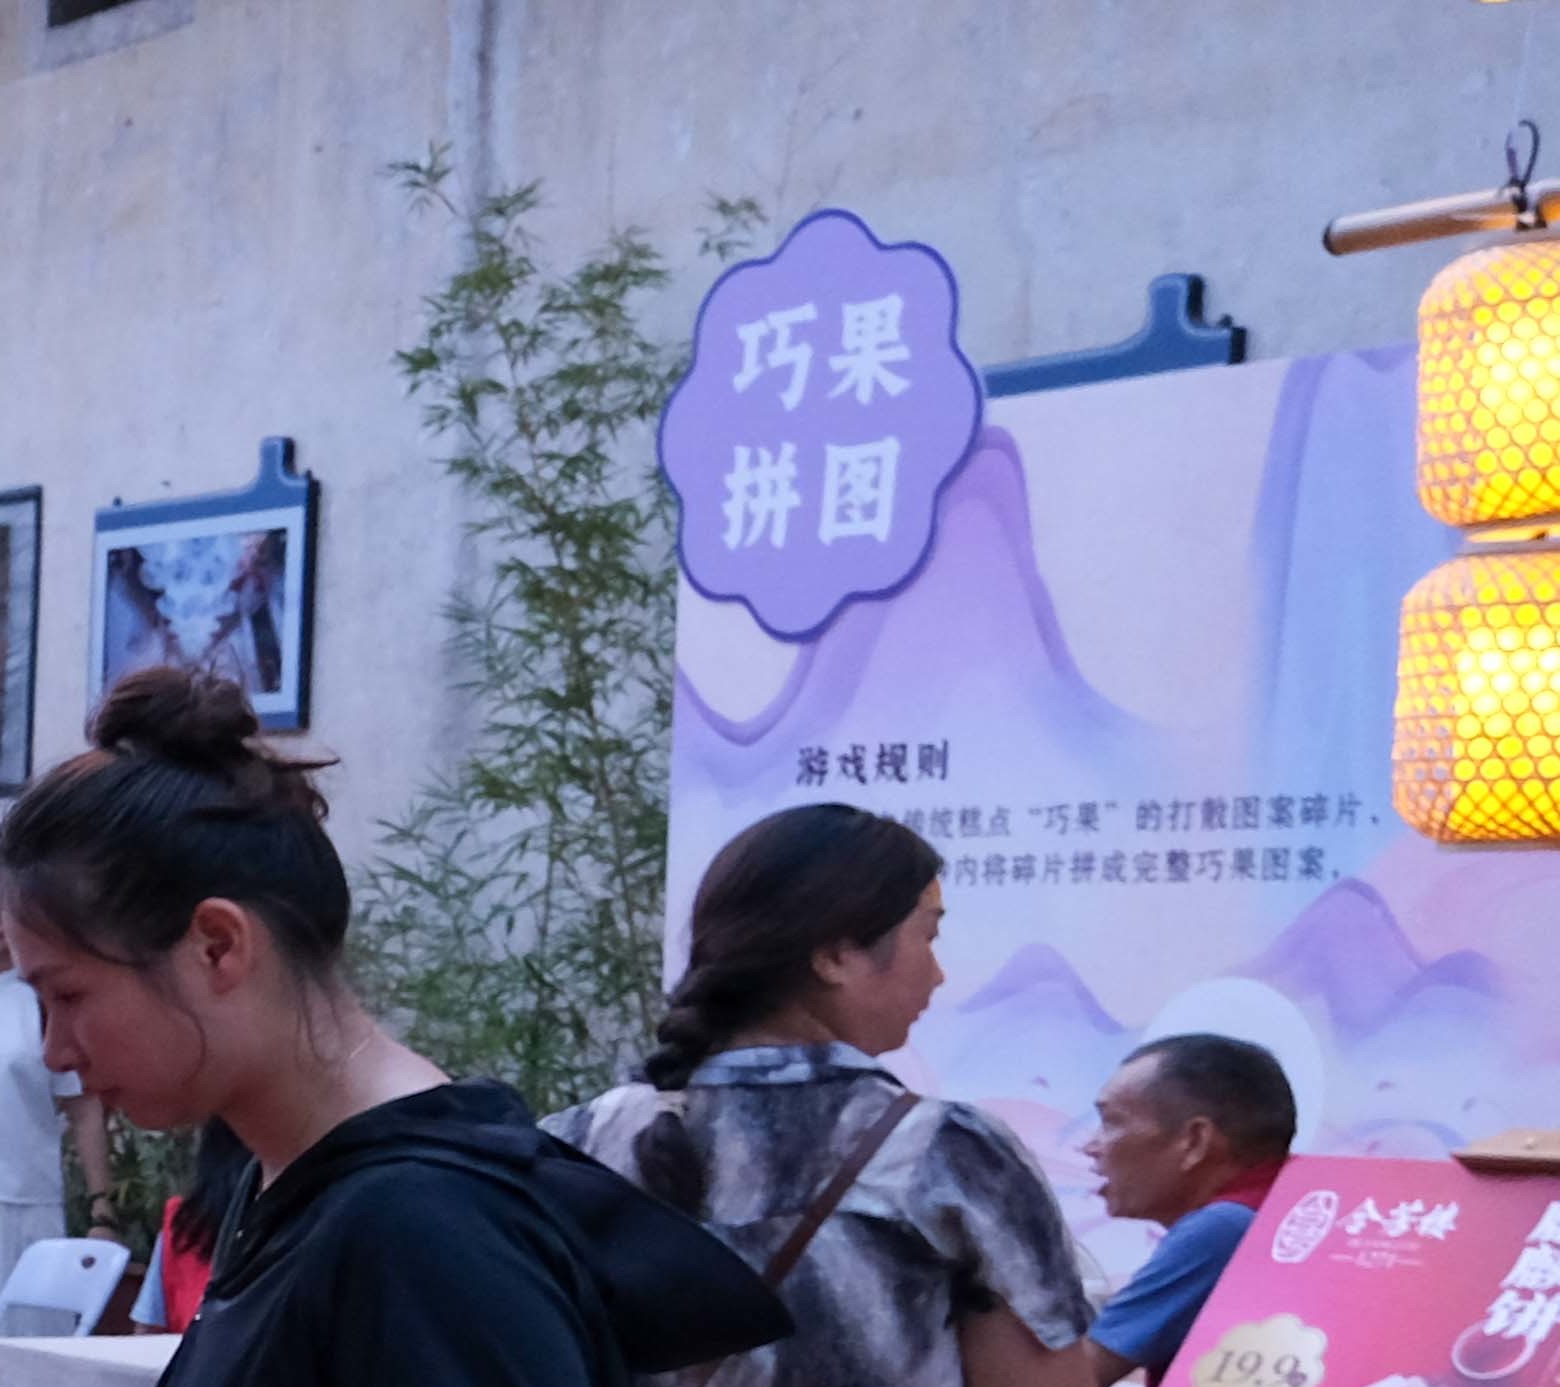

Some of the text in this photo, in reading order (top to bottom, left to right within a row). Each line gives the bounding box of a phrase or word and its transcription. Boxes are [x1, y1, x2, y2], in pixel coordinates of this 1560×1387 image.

[733, 292, 912, 410] 巧果
[721, 436, 902, 550] 拼图
[795, 739, 949, 787] 游戏规则
